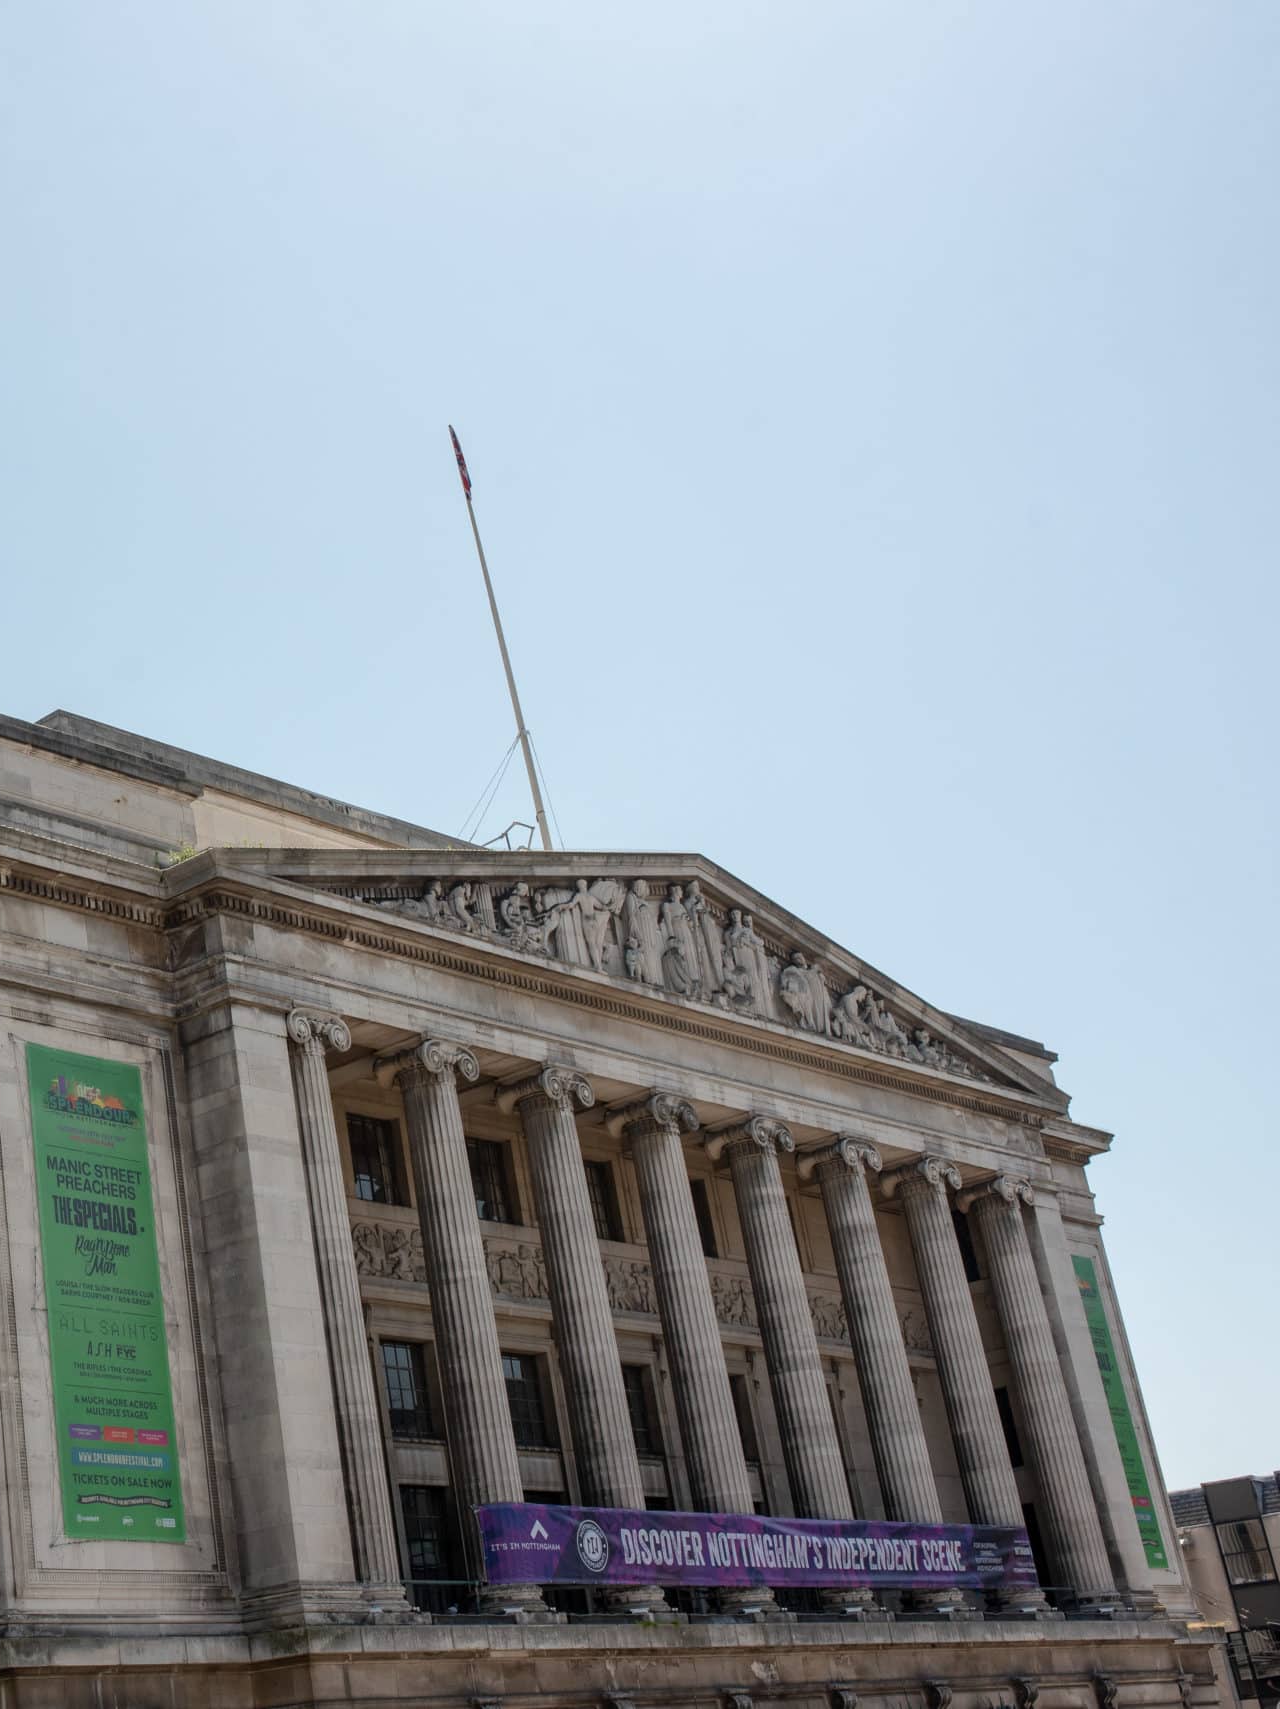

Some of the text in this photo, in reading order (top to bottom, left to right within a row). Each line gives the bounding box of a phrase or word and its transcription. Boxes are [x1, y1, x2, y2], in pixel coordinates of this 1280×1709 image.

[48, 1094, 132, 1125] SPLENDOUR
[47, 1155, 142, 1184] MANIC STREET
[56, 1173, 136, 1201] PREACHERS
[60, 1315, 158, 1341] ALL SAINTS
[87, 1340, 112, 1358] ASH
[81, 1395, 105, 1405] MUCH
[106, 1397, 129, 1408] MORE
[129, 1399, 158, 1410] ACROSS
[121, 1409, 149, 1420] STAGES
[73, 1473, 173, 1489] TICKETS ON SALE NOW
[510, 1542, 521, 1550] IN
[521, 1542, 561, 1552] NOTTINGHAM
[621, 1528, 706, 1567] DISCOVER
[707, 1531, 823, 1570] NOTTINGHAM'S
[824, 1537, 919, 1572] INDEPENDENT
[921, 1540, 967, 1572] SCENE
